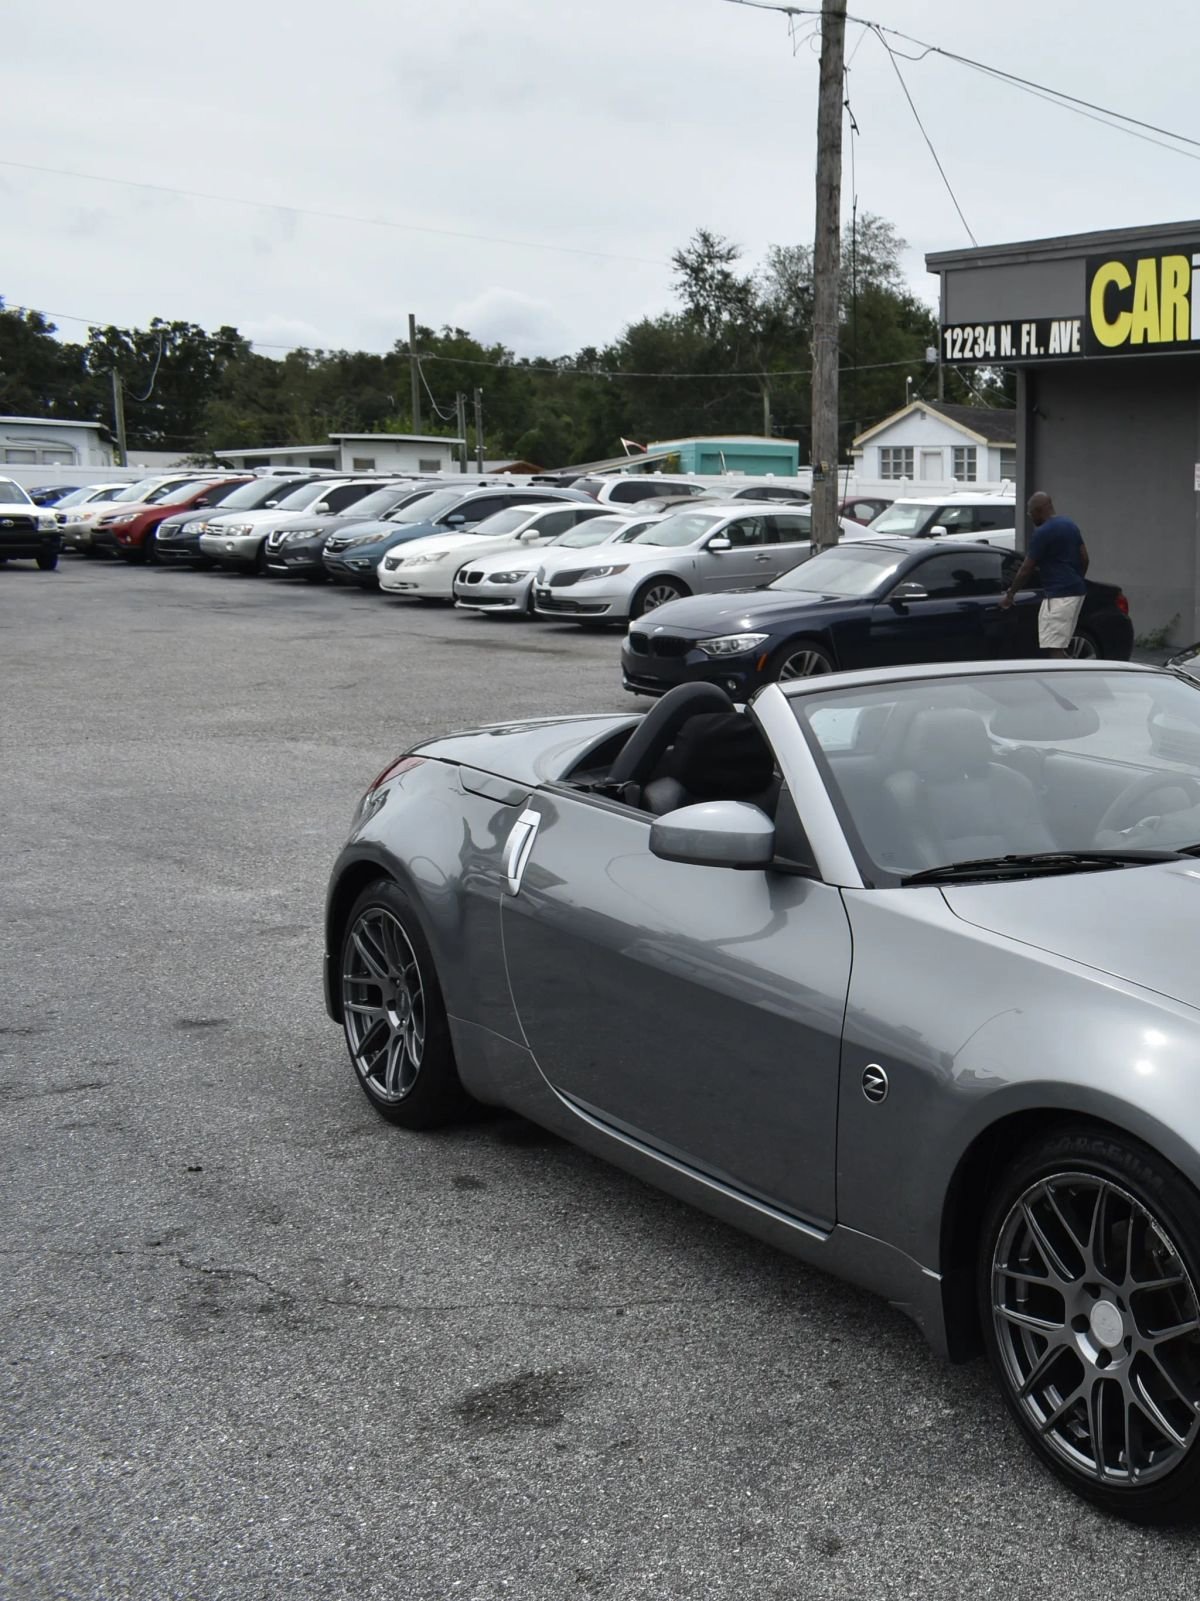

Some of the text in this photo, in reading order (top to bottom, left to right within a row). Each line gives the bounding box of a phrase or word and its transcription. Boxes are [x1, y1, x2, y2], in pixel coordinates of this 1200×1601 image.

[943, 320, 1081, 359] 12234 N. FL. AVE
